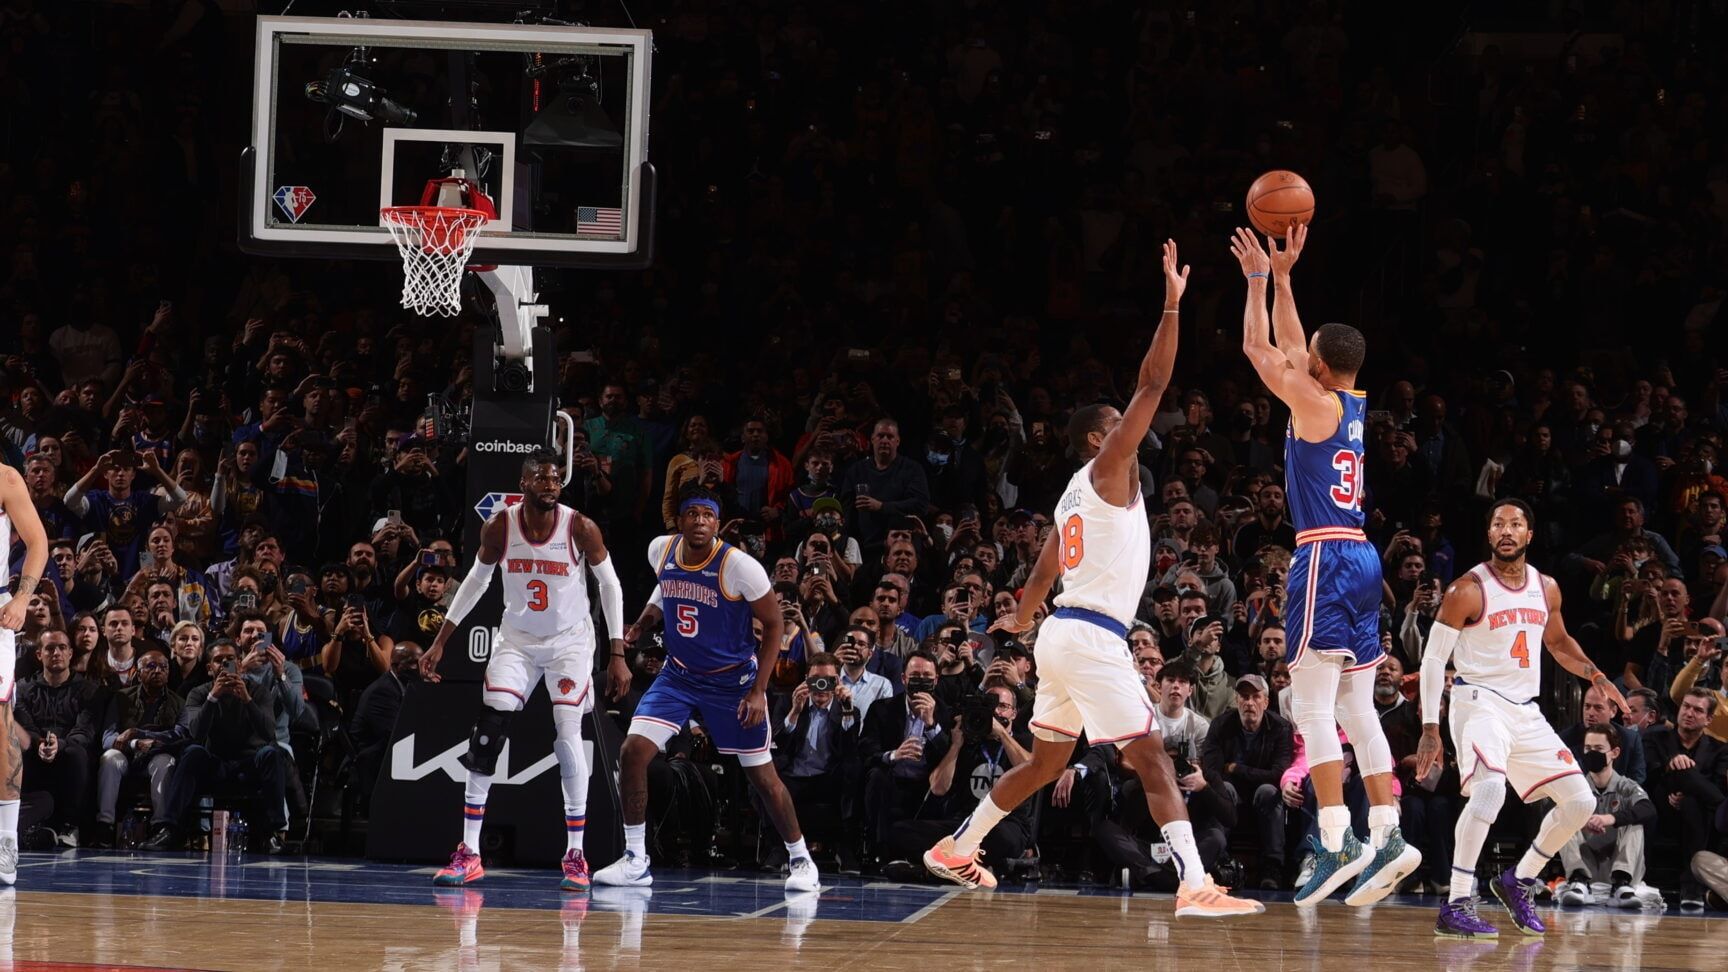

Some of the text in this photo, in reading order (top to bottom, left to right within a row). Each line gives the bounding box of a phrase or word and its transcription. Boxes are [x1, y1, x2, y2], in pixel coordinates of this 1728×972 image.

[298, 191, 306, 203] 75
[507, 558, 569, 577] NEW YORK
[526, 579, 549, 612] 3
[660, 579, 718, 608] WARRIORS
[676, 603, 699, 638] 5
[1488, 608, 1546, 631] NEW YORK
[1510, 630, 1530, 668] 4
